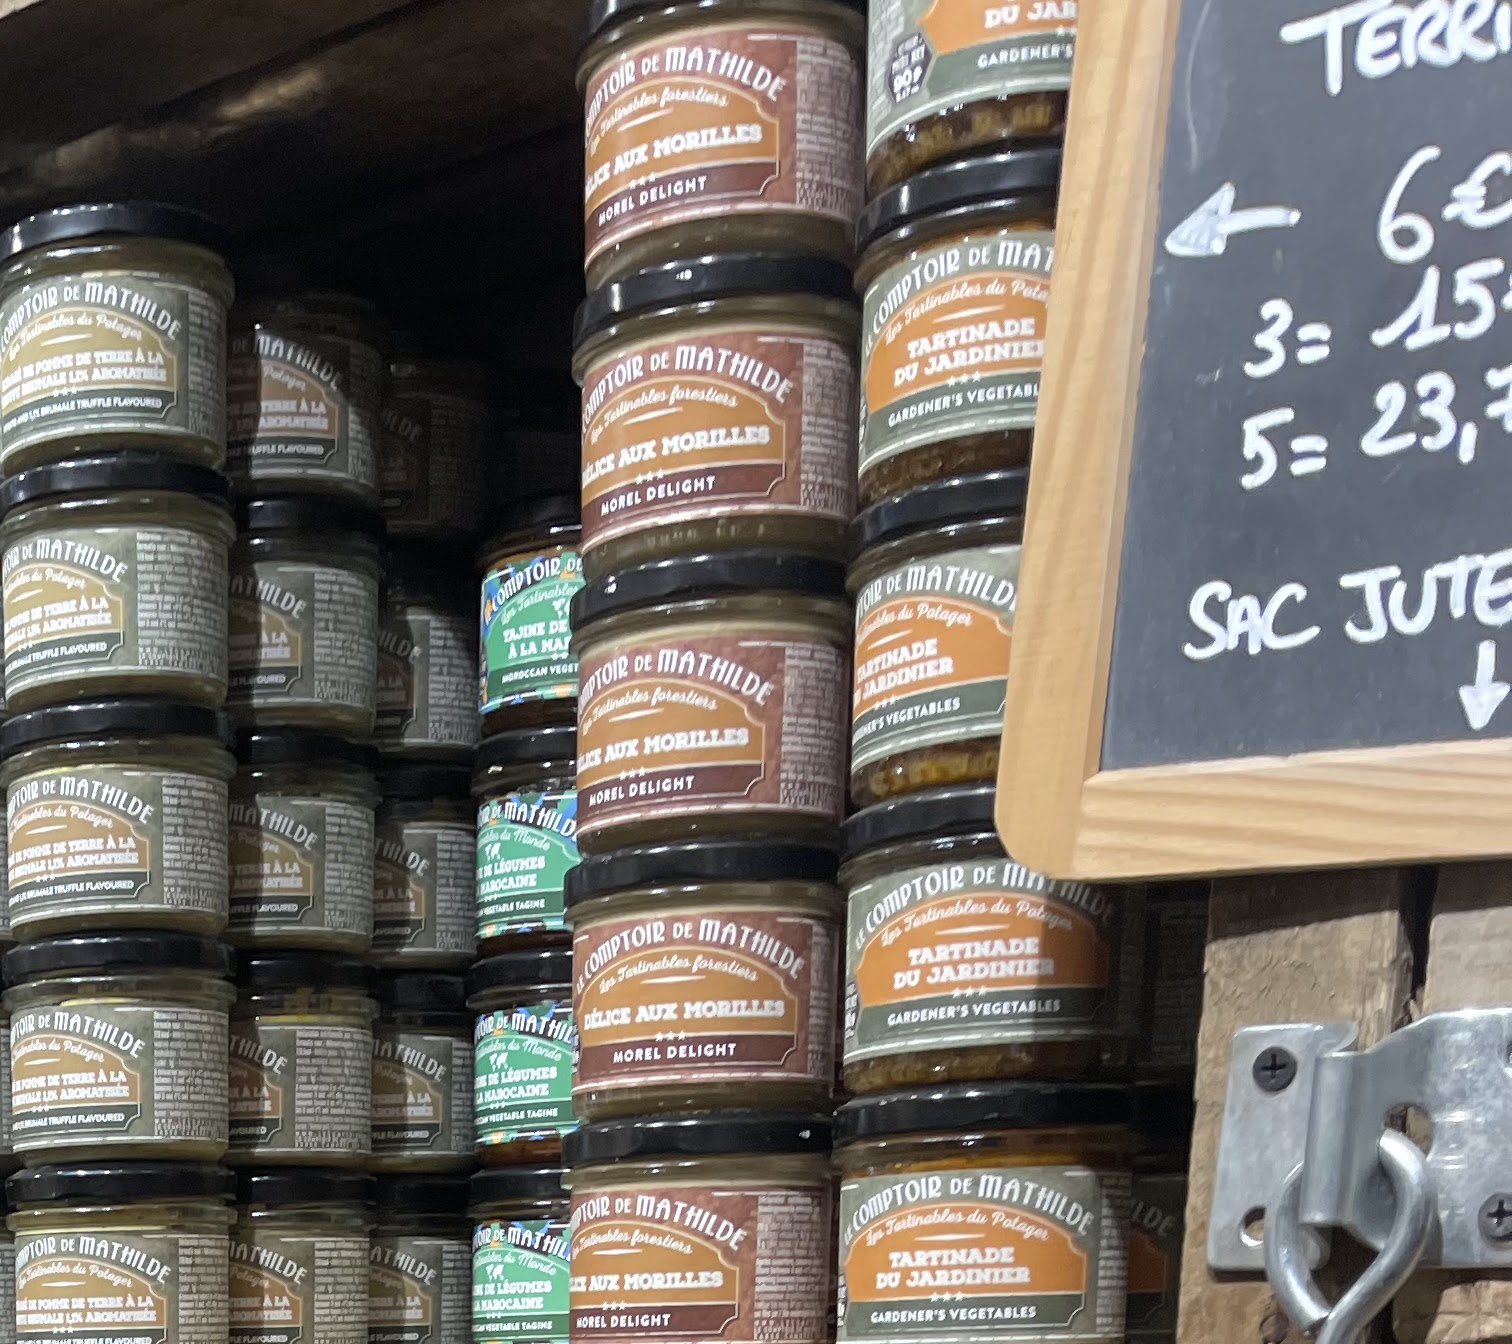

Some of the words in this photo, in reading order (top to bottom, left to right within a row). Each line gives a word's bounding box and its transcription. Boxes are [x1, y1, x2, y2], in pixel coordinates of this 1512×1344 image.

[665, 46, 786, 101] MATHILDE
[613, 144, 649, 175] AUX
[653, 123, 762, 158] MORILLES
[598, 199, 635, 227] MOREL
[639, 176, 707, 206] DELIGHT
[85, 282, 182, 341] MATHILDE
[1370, 258, 1512, 350] 15
[1184, 580, 1321, 660] SAC
[585, 921, 665, 980] COMPTOIR
[673, 923, 692, 939] DE
[698, 919, 805, 980] MATHILDE
[584, 1007, 631, 1031] DÉLICE
[636, 1002, 679, 1023] AUX
[684, 1000, 784, 1019] MORILLES
[613, 1047, 661, 1064] MOREL
[667, 1043, 736, 1059] DELIGHT
[852, 1175, 941, 1231] COMPTOIR
[950, 1178, 971, 1195] DE
[978, 1174, 1094, 1235] MATHILDE
[967, 1210, 987, 1225] du
[992, 1211, 1049, 1241] Potager
[876, 1272, 900, 1289] DU
[906, 1267, 1030, 1287] JARDINIER
[889, 1247, 1015, 1268] TARTINADE
[871, 1309, 945, 1324] GARDENER'S
[950, 1306, 1037, 1321] VEGETABLES
